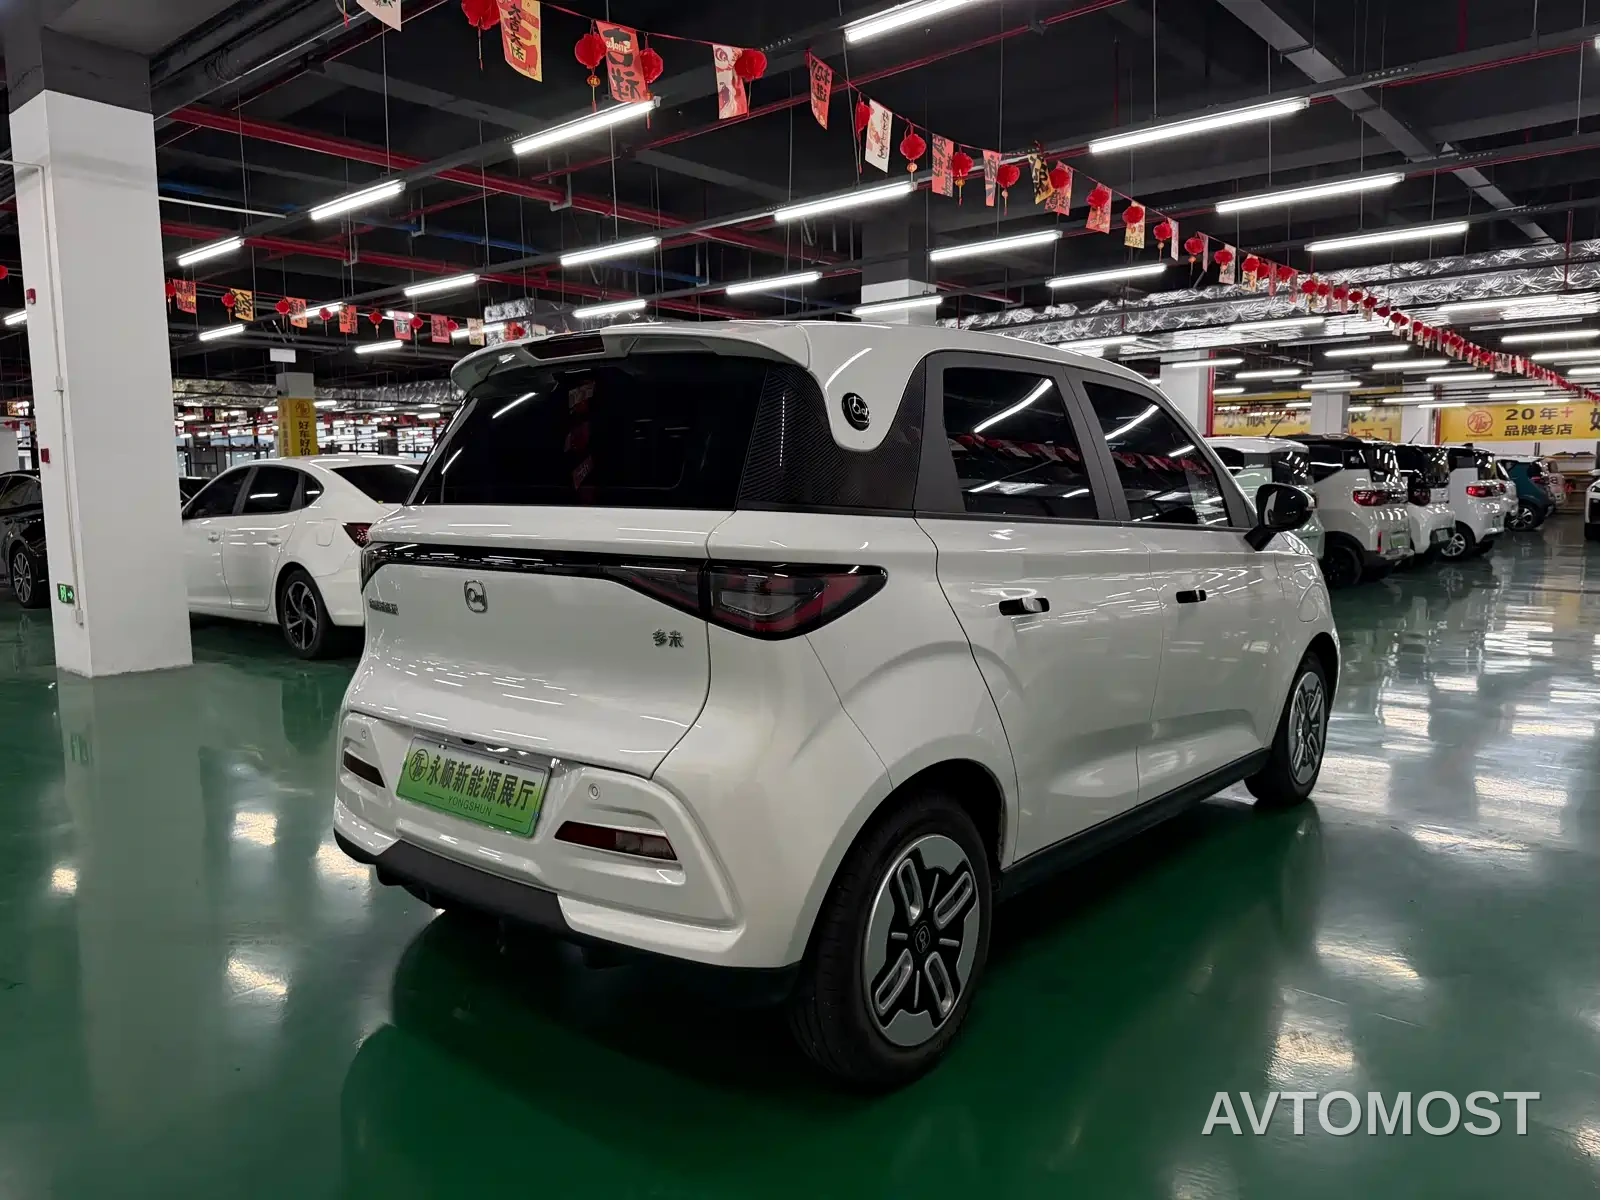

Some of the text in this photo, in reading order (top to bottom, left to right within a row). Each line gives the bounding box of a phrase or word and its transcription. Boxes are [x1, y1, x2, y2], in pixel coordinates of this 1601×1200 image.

[1505, 407, 1574, 421] 20年+
[1504, 423, 1573, 437] 品牌老店
[426, 754, 536, 811] 永顺新能源展厅
[447, 795, 493, 816] YONGSHUN
